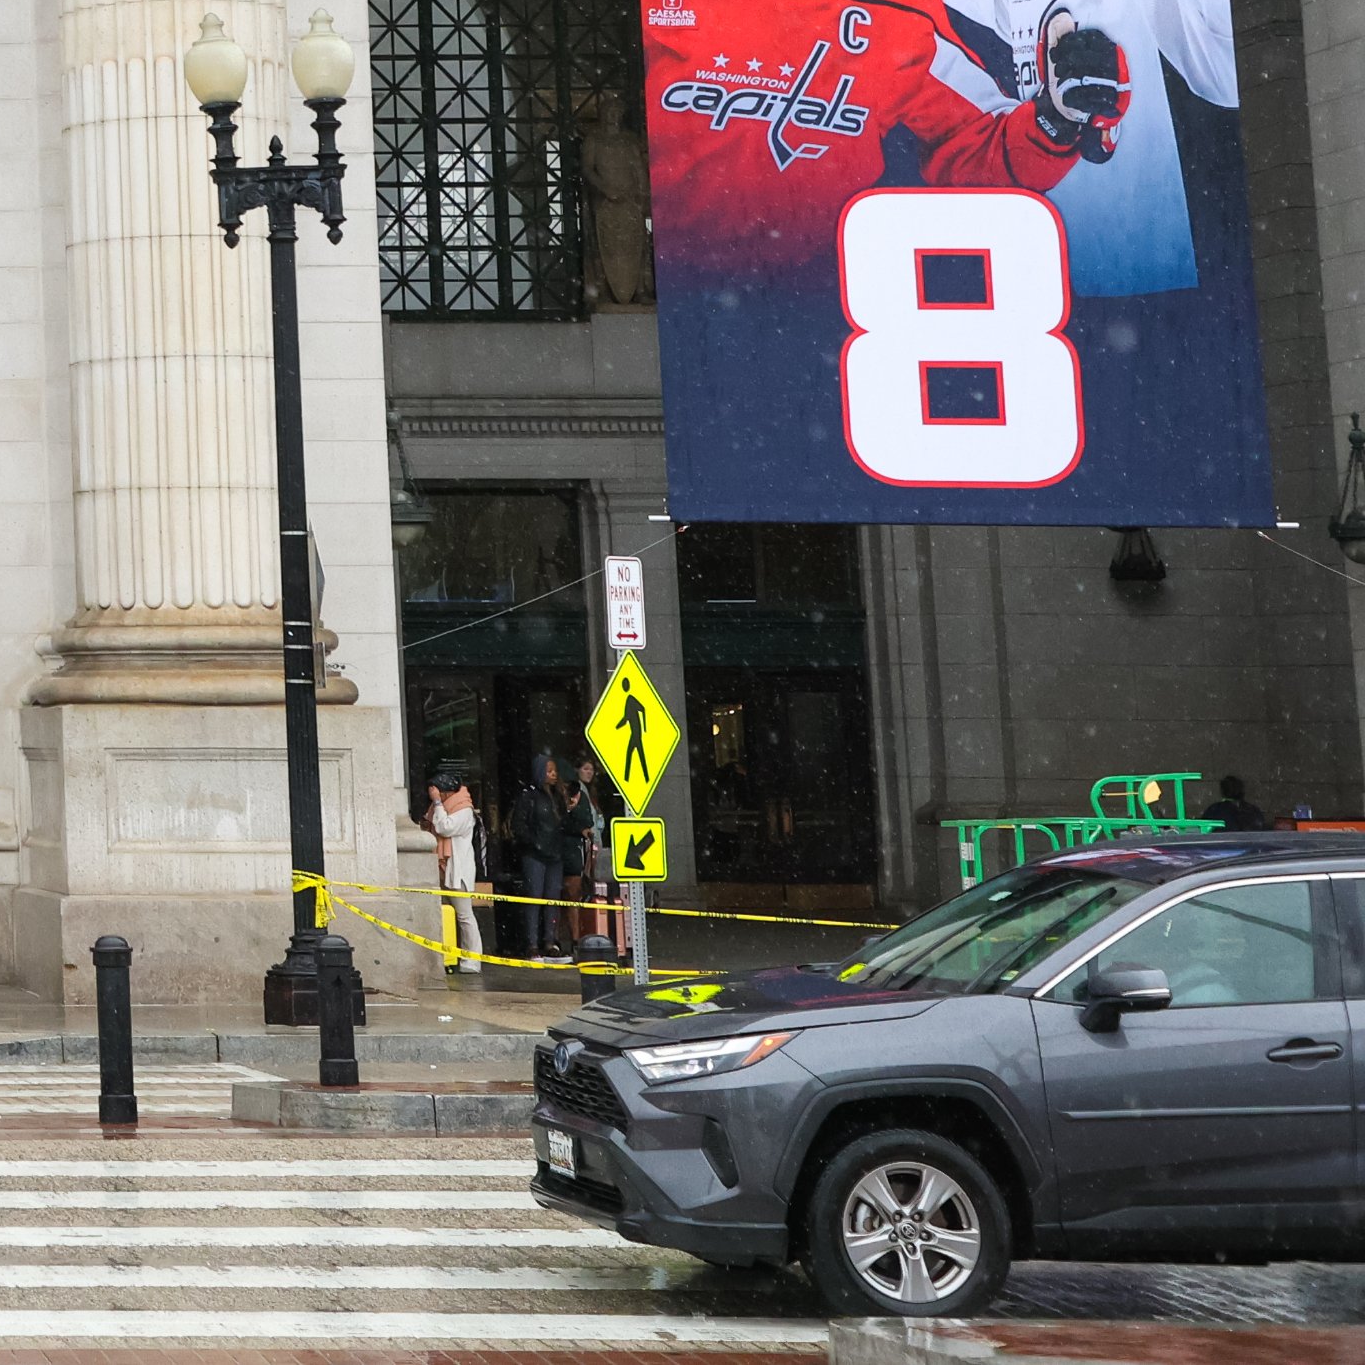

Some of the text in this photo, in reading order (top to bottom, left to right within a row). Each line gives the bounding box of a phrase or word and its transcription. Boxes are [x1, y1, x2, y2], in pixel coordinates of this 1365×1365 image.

[648, 9, 696, 19] CAESARS
[648, 17, 696, 26] SPORTSBOOK
[839, 6, 872, 54] C
[695, 69, 790, 90] WASHINGTON
[661, 40, 869, 172] capitals
[838, 187, 1085, 489] 8
[617, 566, 631, 583] NO
[610, 586, 641, 602] PARKING
[619, 604, 633, 615] ANY
[618, 617, 635, 629] TIME
